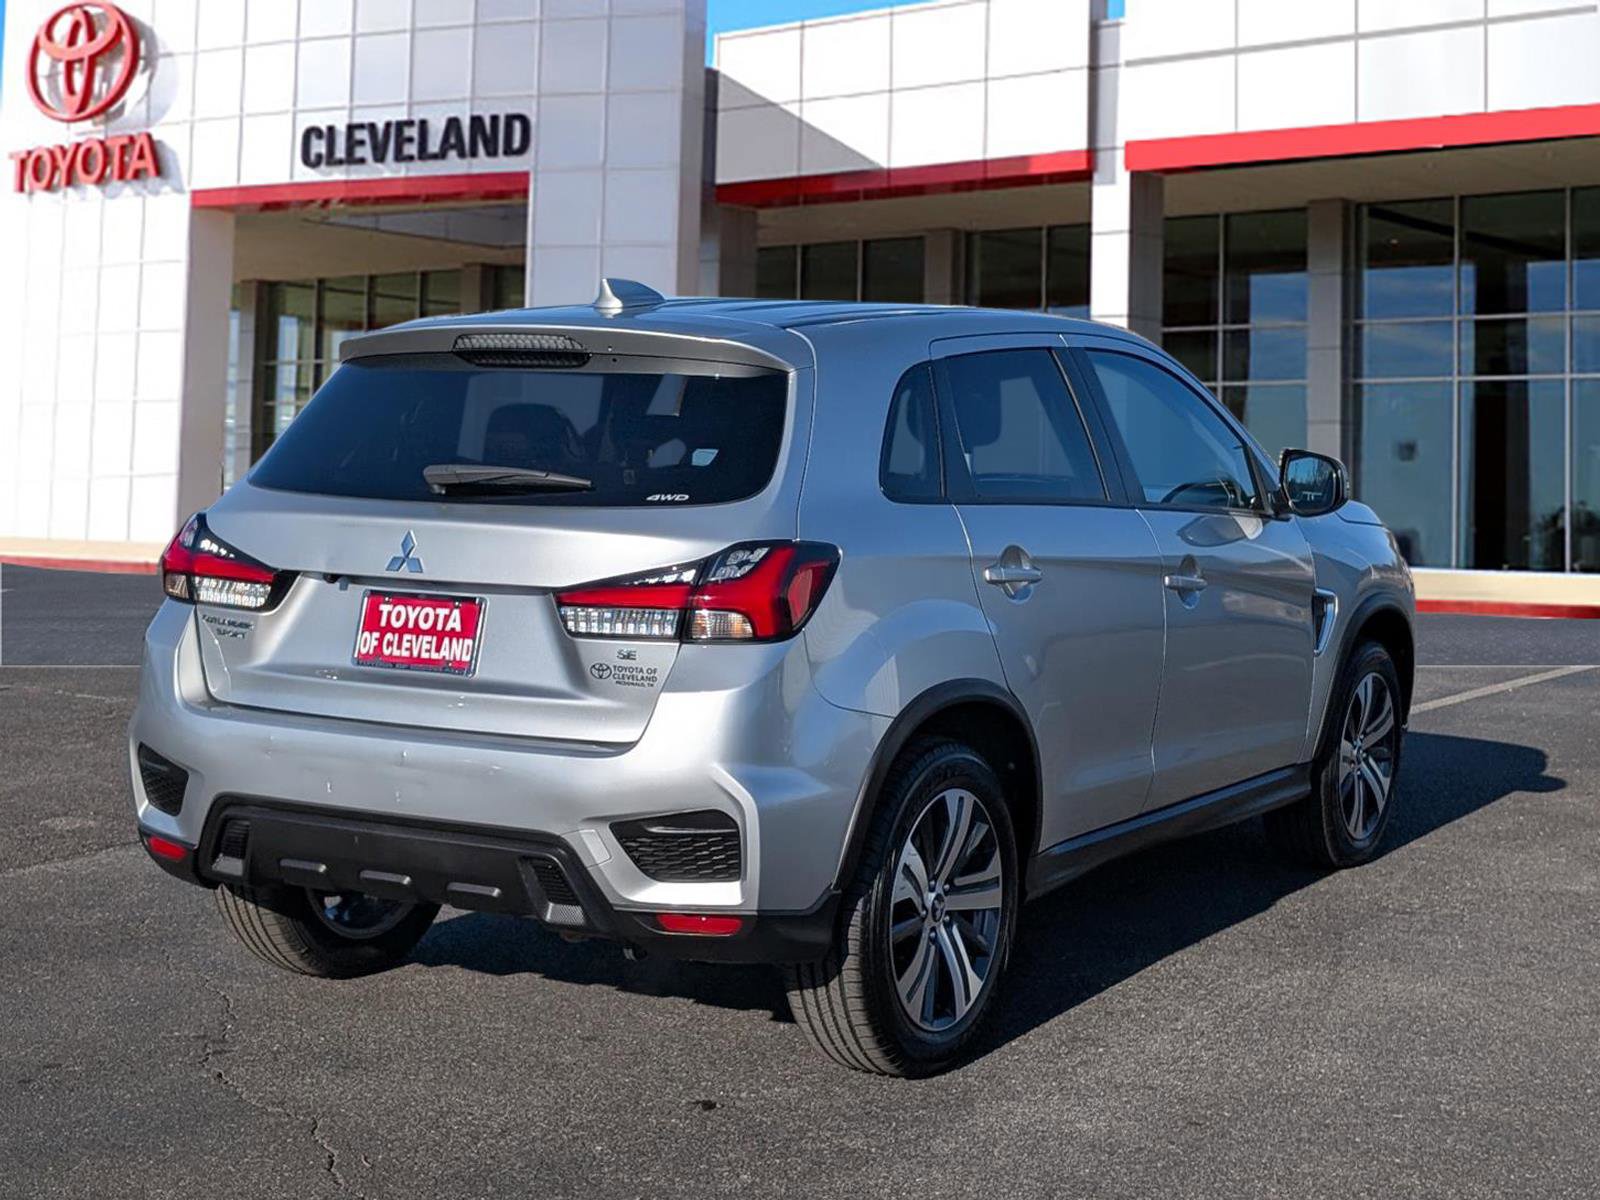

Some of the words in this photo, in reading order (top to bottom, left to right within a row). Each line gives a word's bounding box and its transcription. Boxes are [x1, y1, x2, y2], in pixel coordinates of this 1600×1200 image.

[301, 113, 532, 169] CLEVELAND
[9, 132, 161, 193] TOYOTA
[646, 493, 689, 501] 4WD
[378, 603, 462, 632] TOYOTA
[360, 631, 380, 655] OF
[382, 632, 474, 662] CLEVELAND
[616, 648, 637, 660] SE
[612, 665, 644, 674] TOYOTA
[646, 667, 658, 675] OF
[612, 673, 658, 682] CLEVELAND
